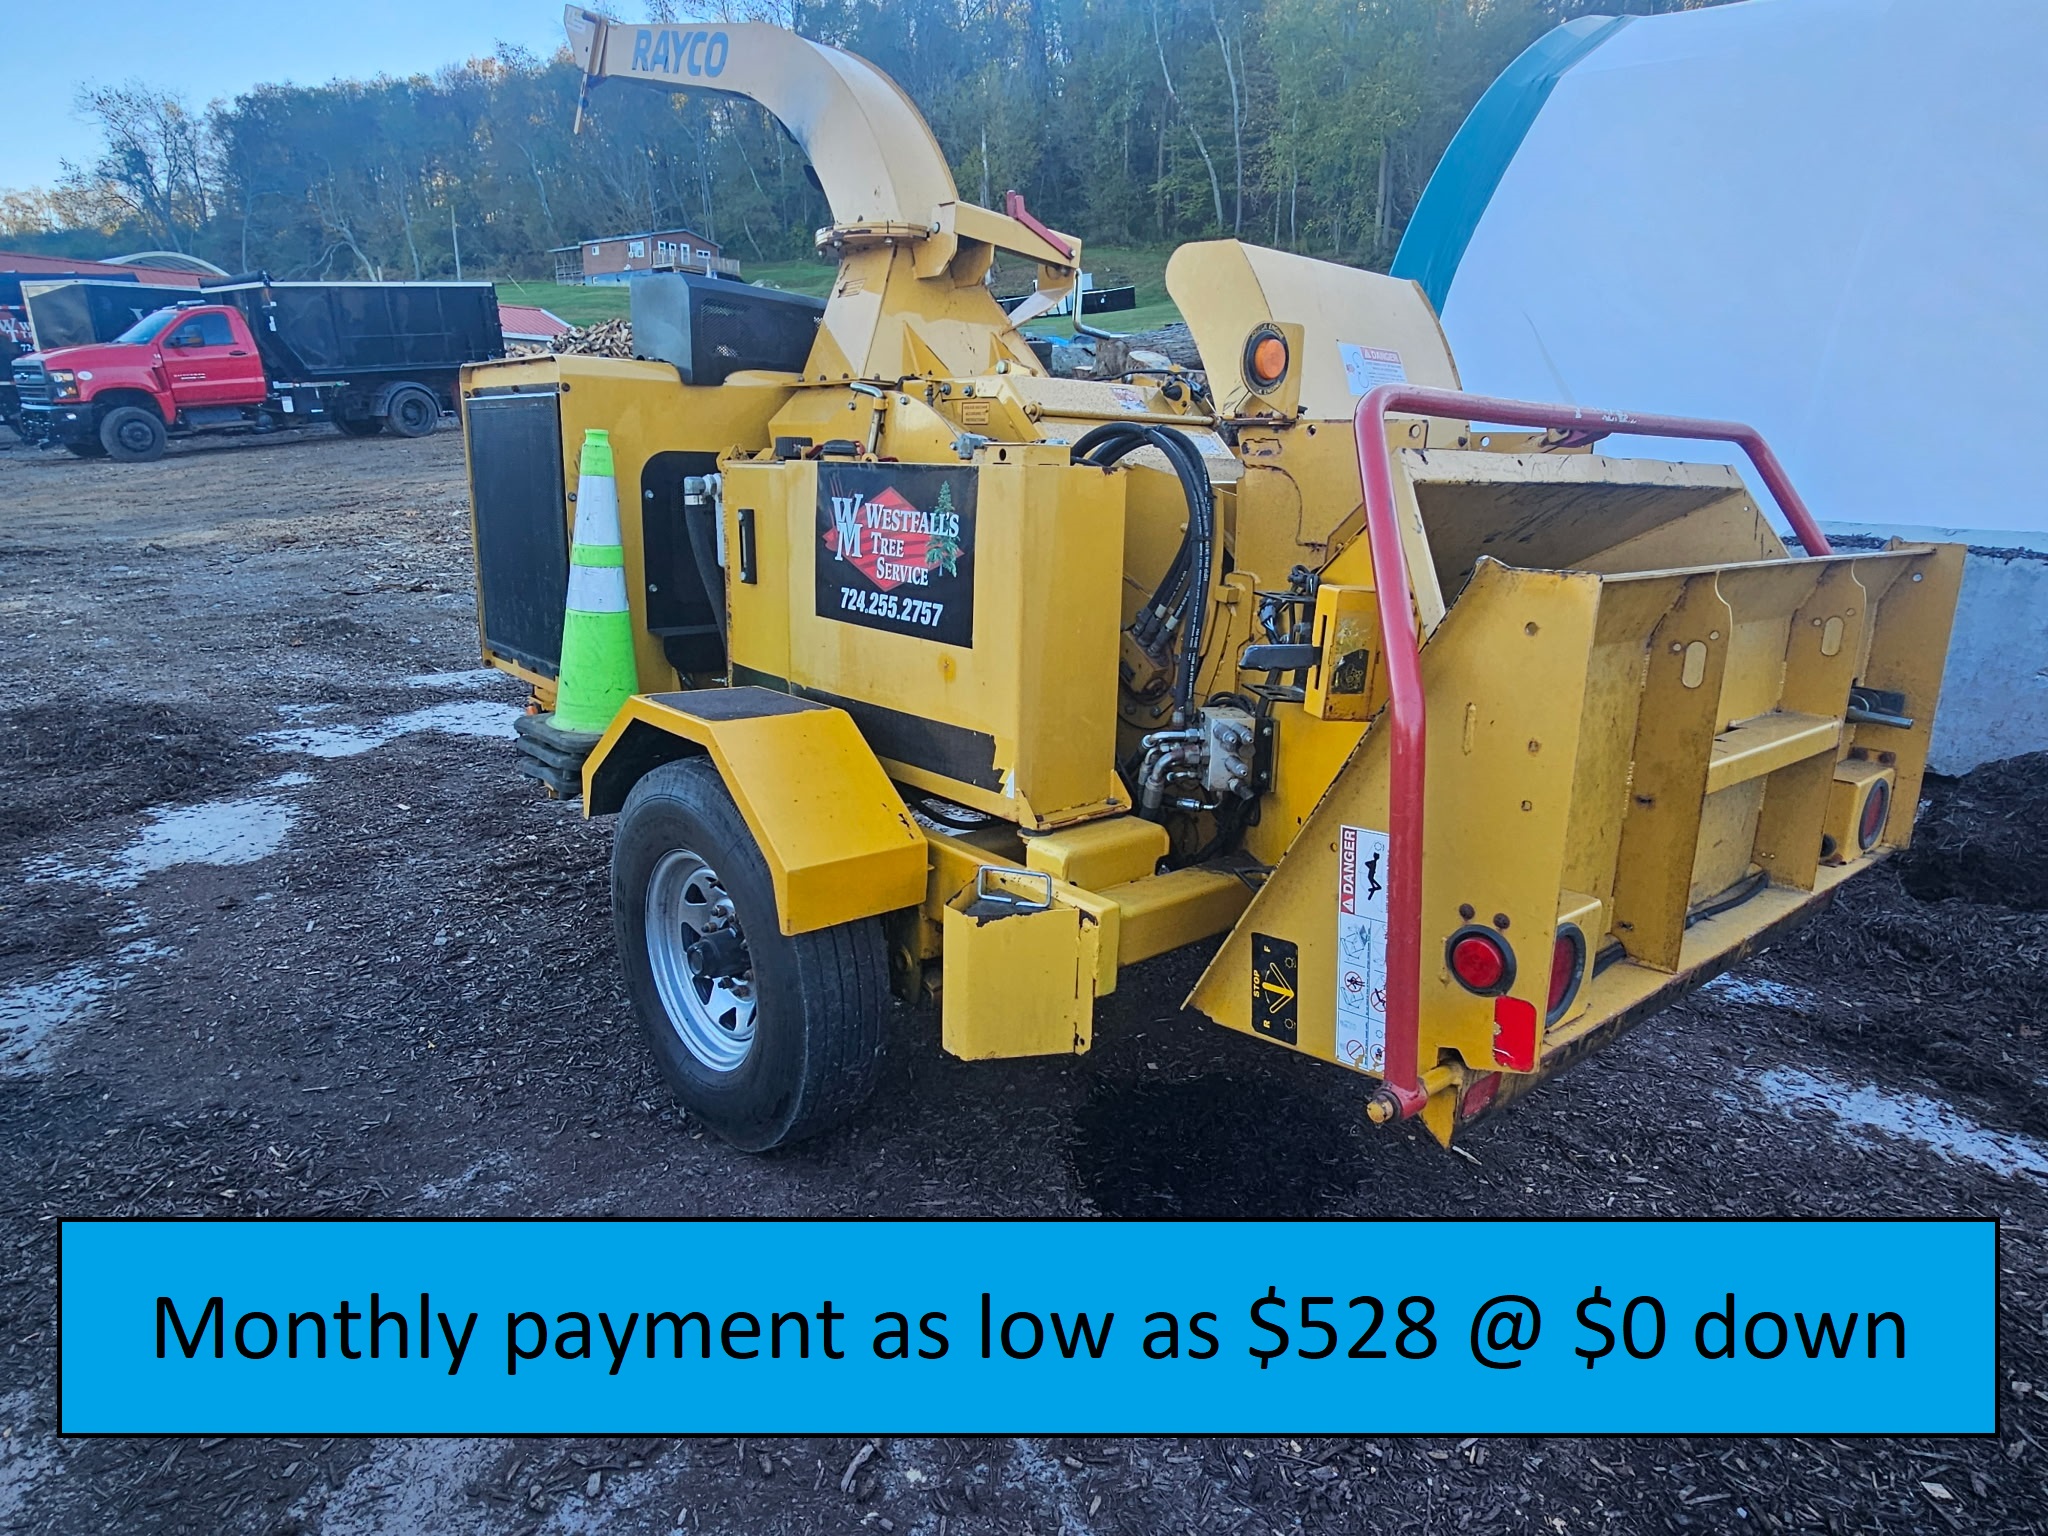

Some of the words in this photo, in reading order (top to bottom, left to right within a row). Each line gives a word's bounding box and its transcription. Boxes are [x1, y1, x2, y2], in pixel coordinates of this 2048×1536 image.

[631, 29, 730, 78] RAYCO
[864, 502, 960, 538] WESTFALL'S
[870, 531, 905, 558] TREE
[876, 556, 929, 586] SERVICE
[840, 587, 944, 628] 724.255.2757
[1343, 830, 1356, 895] DANGER
[1263, 945, 1271, 953] F
[1253, 969, 1261, 998] STOP
[1263, 1019, 1271, 1029] R
